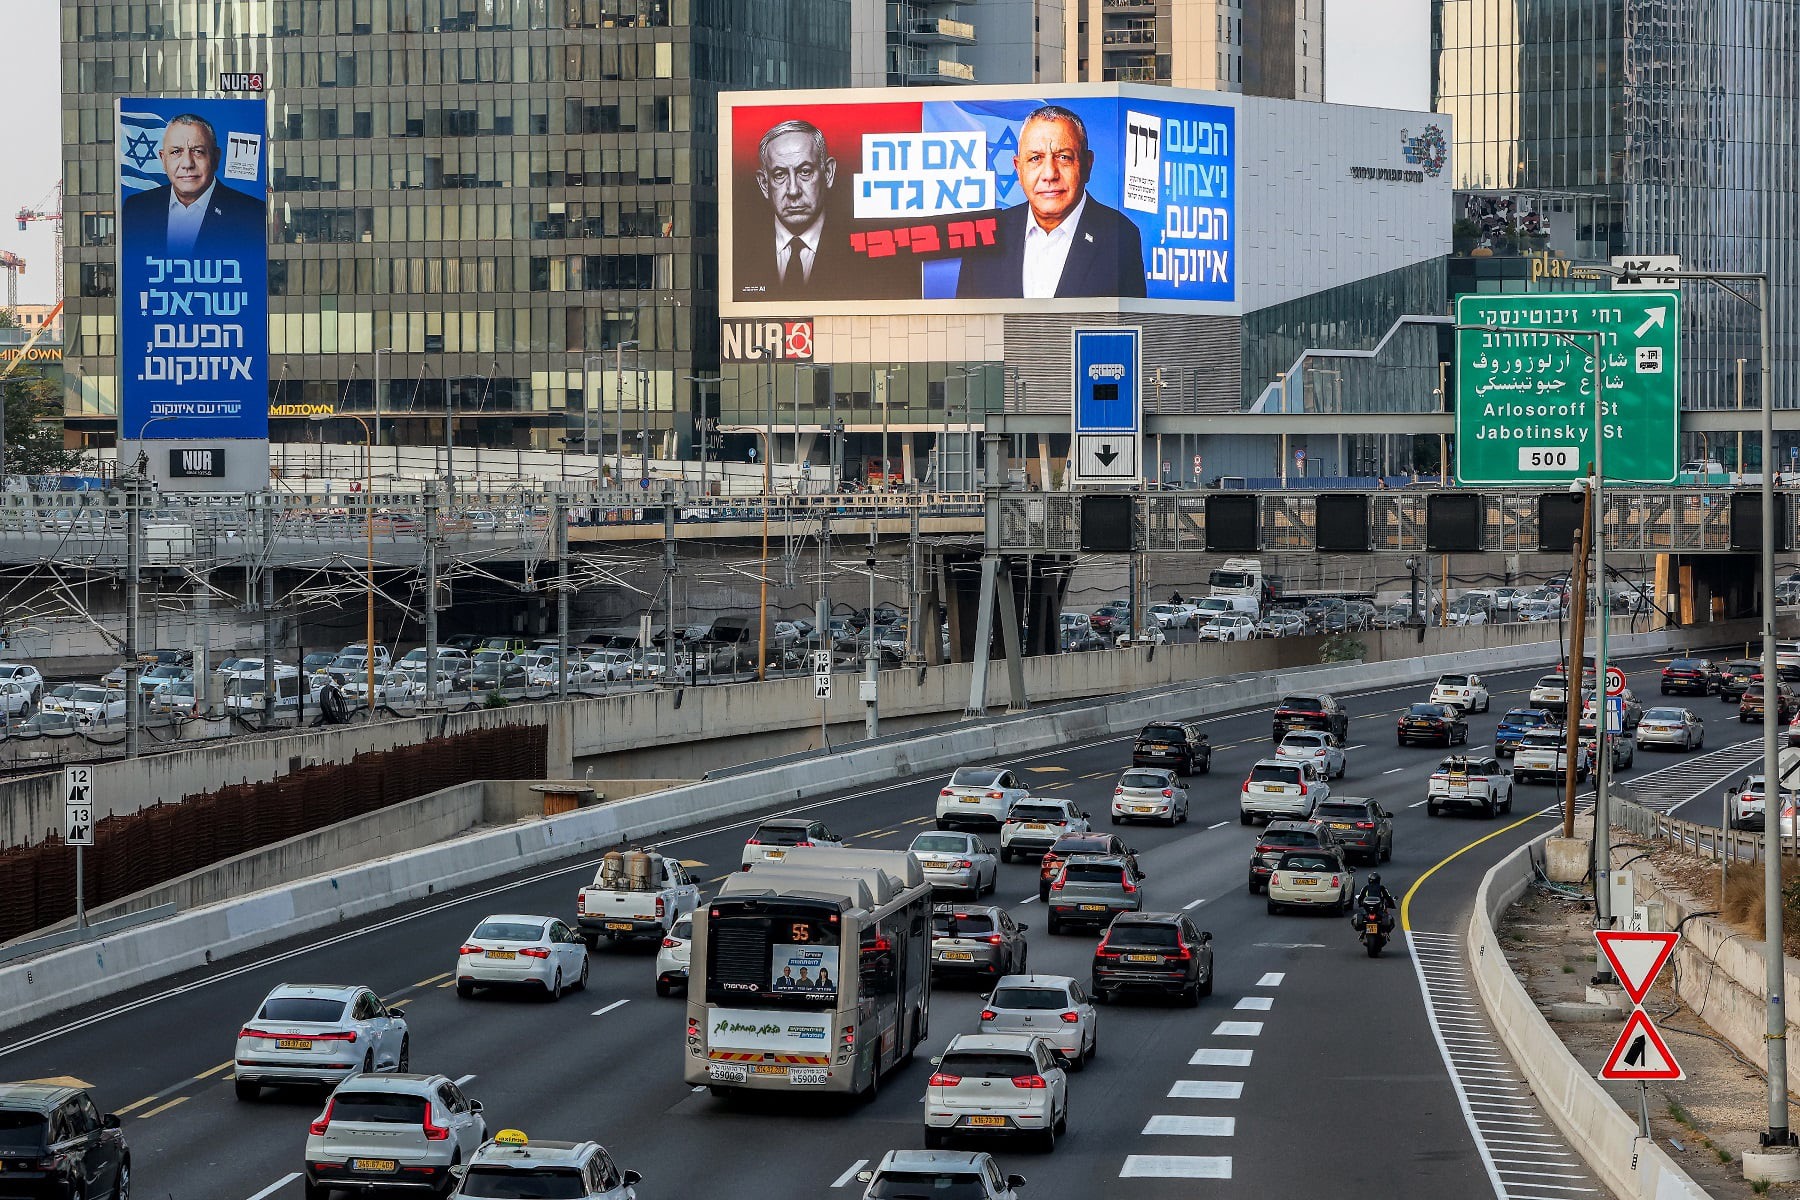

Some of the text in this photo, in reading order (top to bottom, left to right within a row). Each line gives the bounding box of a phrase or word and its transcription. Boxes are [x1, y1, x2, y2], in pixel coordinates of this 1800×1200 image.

[221, 74, 249, 90] NUR
[230, 137, 258, 159] דרך
[1129, 122, 1158, 168] דרך
[1166, 118, 1228, 157] הפעם
[871, 139, 977, 171] אם זה
[1164, 161, 1228, 202] ניצחון!
[863, 176, 986, 210] לא גדי
[1160, 204, 1228, 245] הפעם,
[850, 218, 997, 259] זה ביבי
[146, 255, 243, 284] בשביל
[1147, 247, 1229, 288] איזנקוט.
[1532, 250, 1572, 283] play
[139, 288, 248, 317] ישראל!
[1592, 309, 1622, 324] רח'
[146, 324, 244, 354] הפעם,
[723, 322, 783, 360] NUR
[138, 356, 253, 386] איזנקוט.
[1583, 353, 1628, 373] شارع
[1580, 375, 1624, 396] شاع
[198, 404, 214, 413] עם
[270, 404, 334, 416] MIDTOWN
[1483, 401, 1618, 417] Arlosoroff St
[694, 417, 716, 432] WRK
[1476, 424, 1623, 443] Jabotinsky St
[182, 450, 213, 471] NUR
[1531, 452, 1567, 466] 500
[817, 653, 828, 662] 12
[818, 677, 829, 686] 13
[1606, 676, 1620, 688] 90
[65, 769, 87, 783] 12
[72, 809, 89, 822] 13
[792, 923, 809, 941] 55
